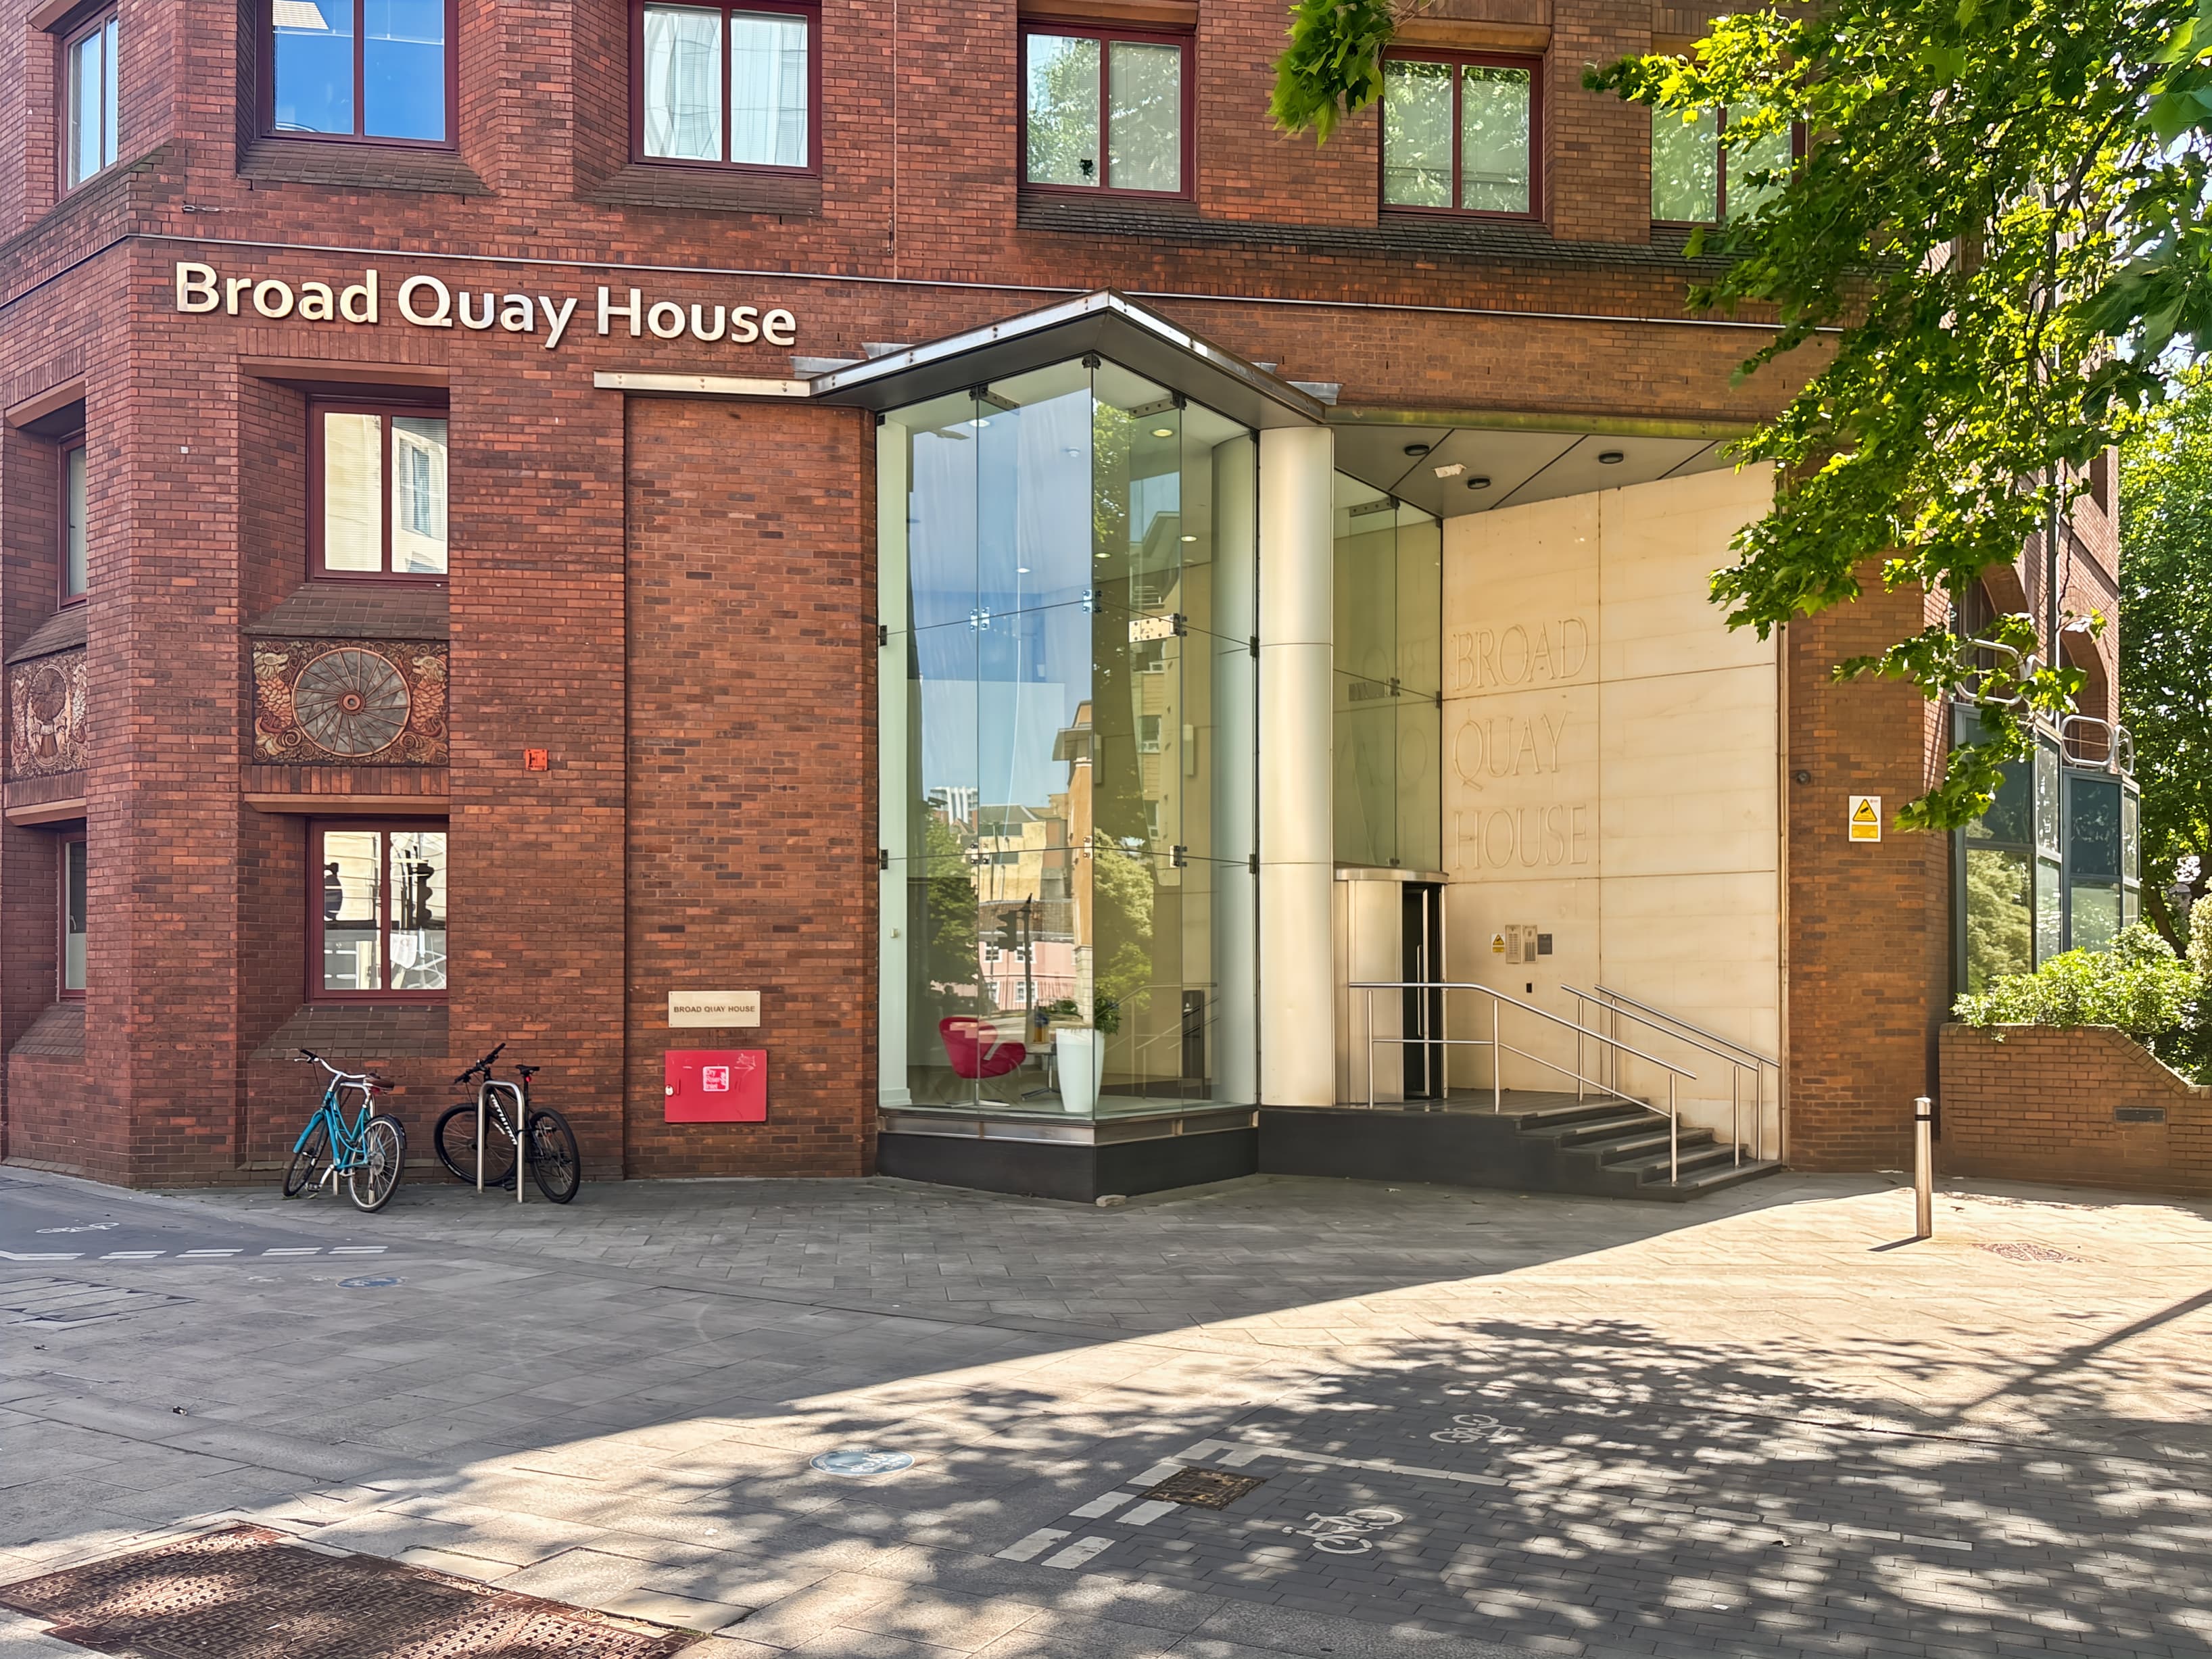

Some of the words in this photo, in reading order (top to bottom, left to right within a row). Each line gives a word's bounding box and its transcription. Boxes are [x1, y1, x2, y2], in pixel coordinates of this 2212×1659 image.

[176, 261, 379, 324] Broad
[398, 275, 577, 349] Quay
[598, 286, 797, 346] House
[1453, 616, 1588, 692] BROAD
[1453, 711, 1570, 791] QUAY
[1453, 804, 1589, 870] HOUSE
